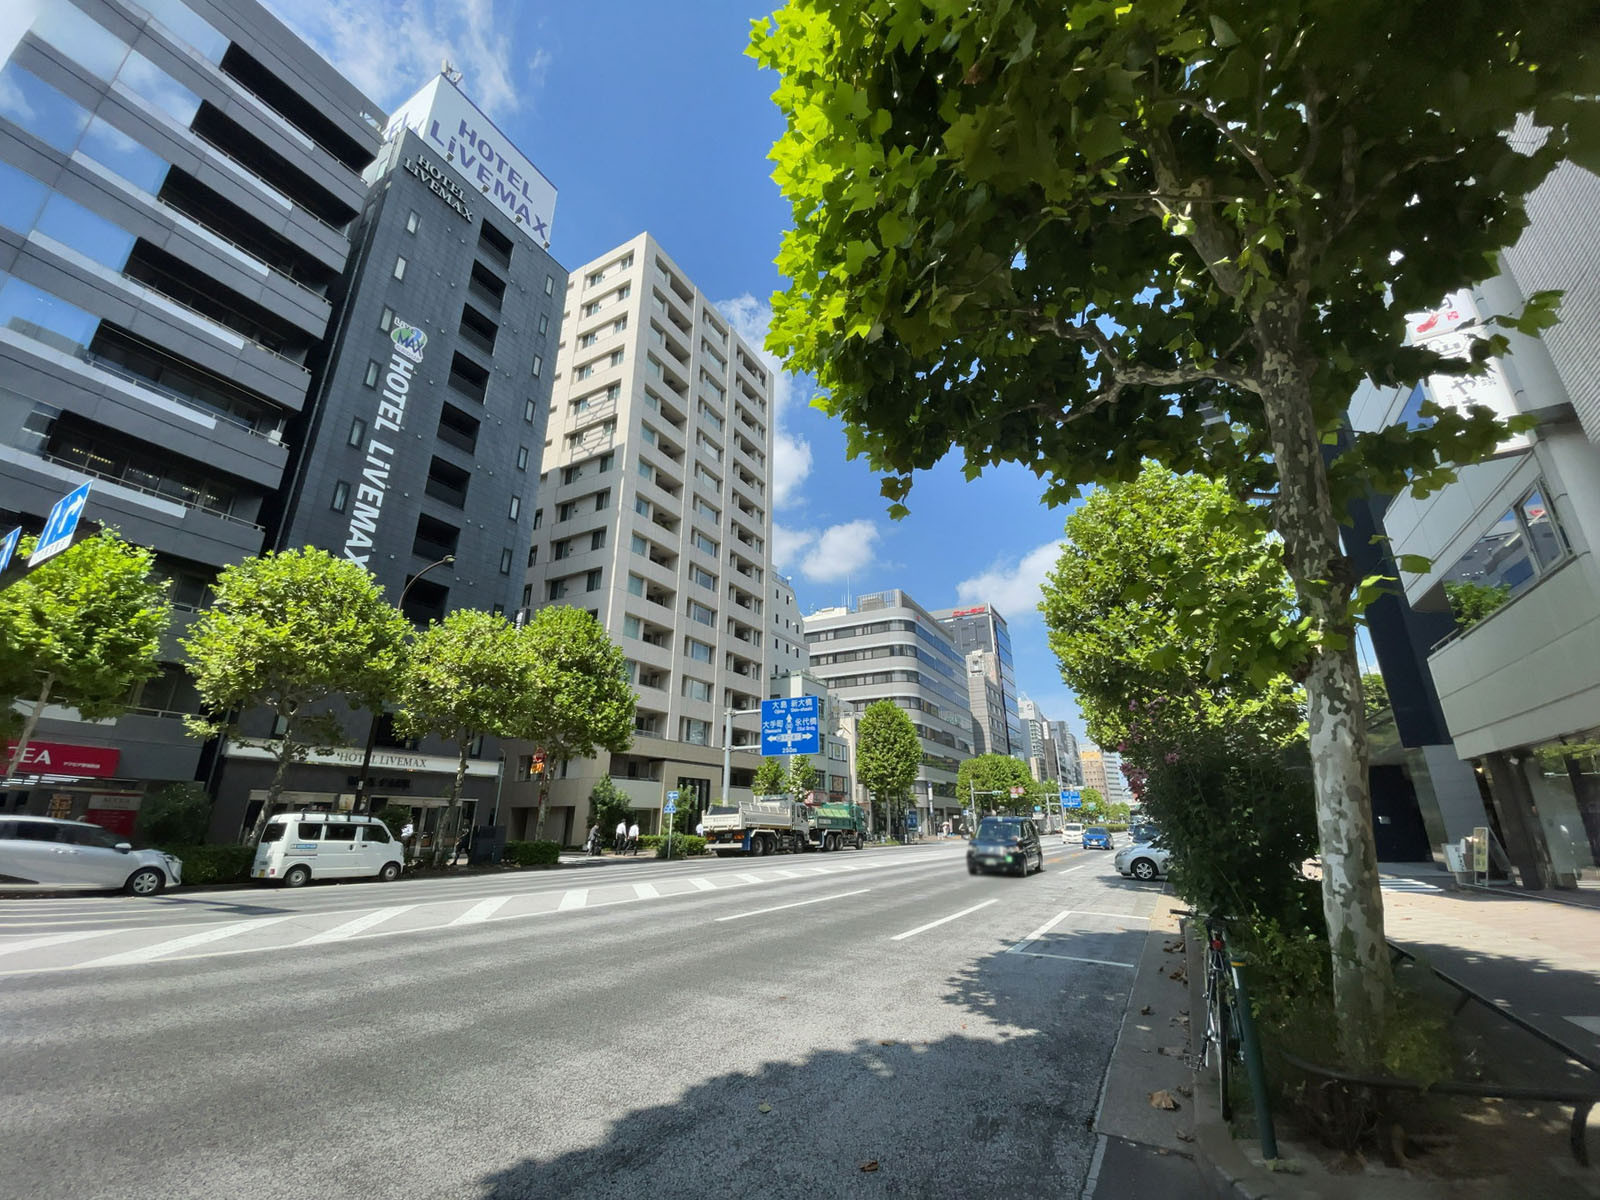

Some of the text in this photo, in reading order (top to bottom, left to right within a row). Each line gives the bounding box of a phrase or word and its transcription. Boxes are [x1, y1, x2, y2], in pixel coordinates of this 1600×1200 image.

[417, 154, 467, 204] HOTEL
[458, 119, 533, 204] HOTEL
[374, 353, 414, 433] HOTEL
[762, 719, 783, 729] 大手町
[340, 751, 377, 765] HOTL
